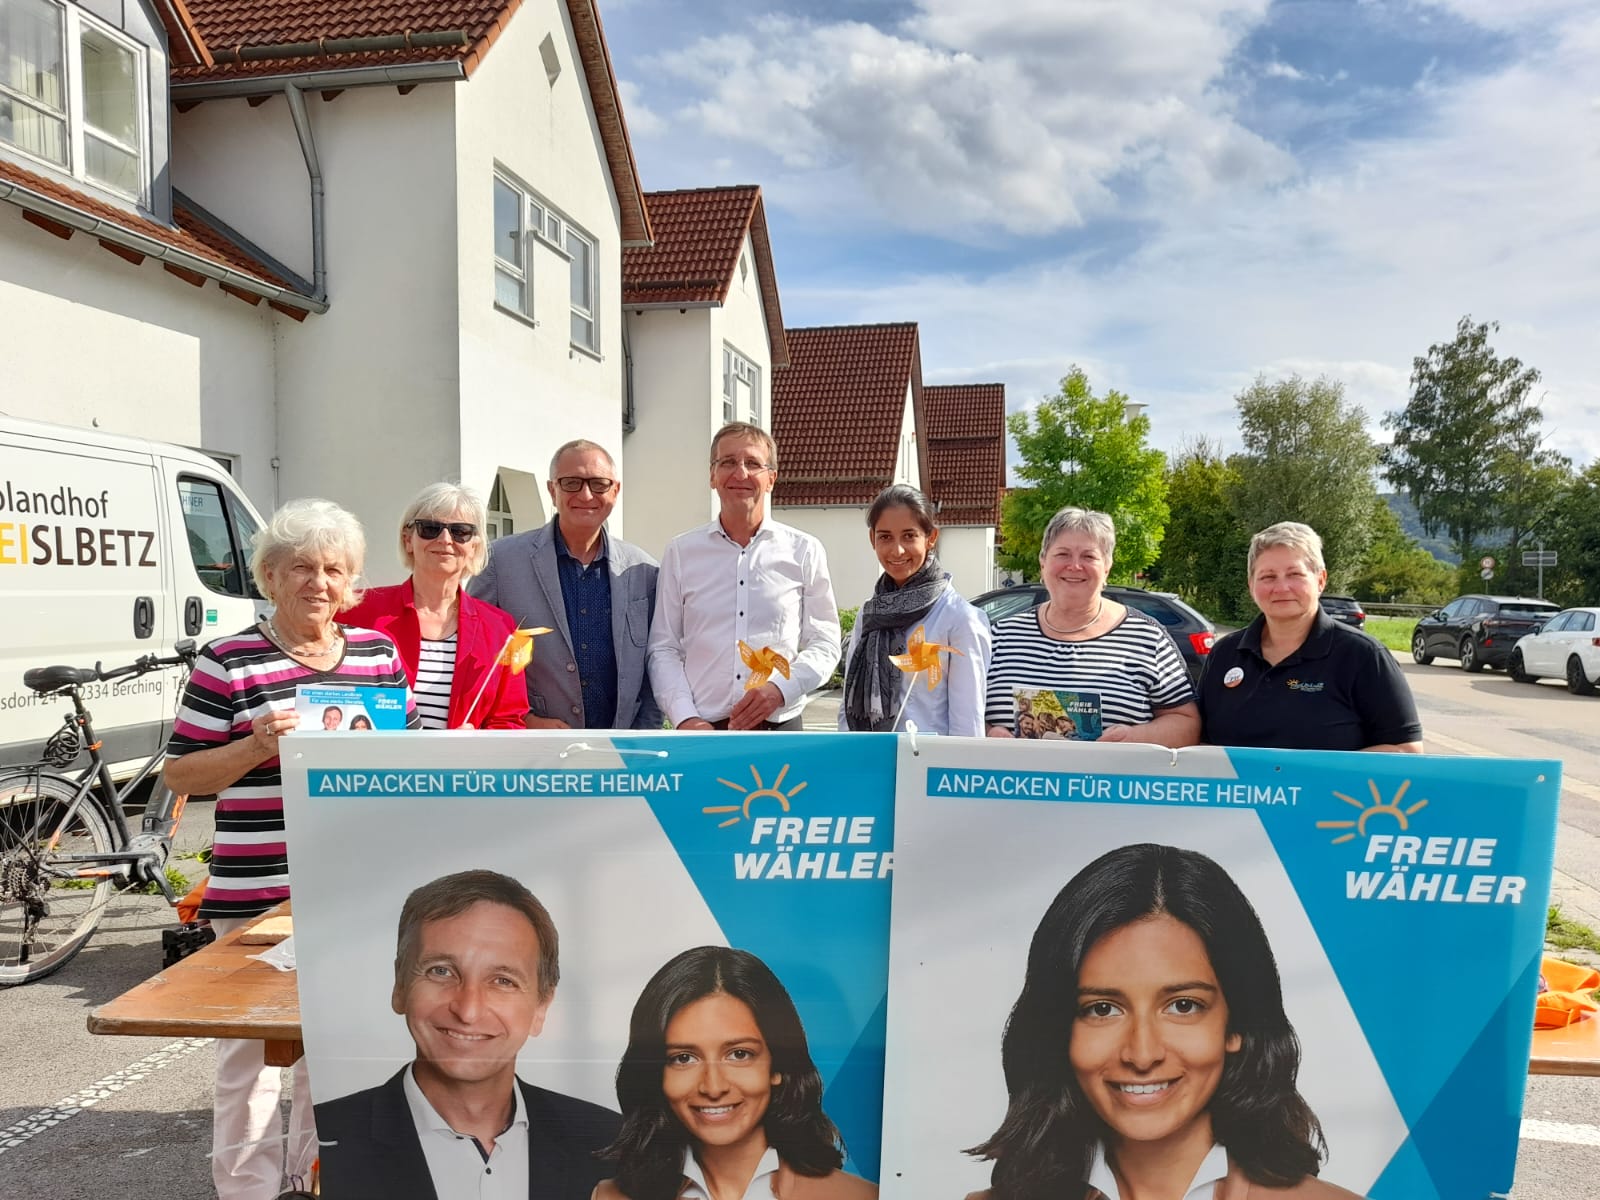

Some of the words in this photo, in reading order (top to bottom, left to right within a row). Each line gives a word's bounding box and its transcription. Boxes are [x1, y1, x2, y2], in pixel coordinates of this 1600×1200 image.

[0, 522, 157, 567] EISLBETZ
[77, 683, 108, 701] 2334
[112, 679, 162, 698] Berching
[1067, 706, 1098, 714] WÄHLER
[319, 773, 444, 793] ANPACKEN
[452, 770, 496, 793] FÜR
[503, 773, 593, 793] UNSERE
[600, 773, 683, 793] HEIMAT
[937, 773, 1060, 797] ANPACKEN
[1068, 775, 1111, 799] FÜR
[1118, 781, 1209, 803] UNSERE
[1216, 784, 1301, 806] HEIMAT
[750, 816, 875, 845] FREIE
[1364, 834, 1497, 867] FREIE
[1345, 862, 1527, 904] WÄHLER
